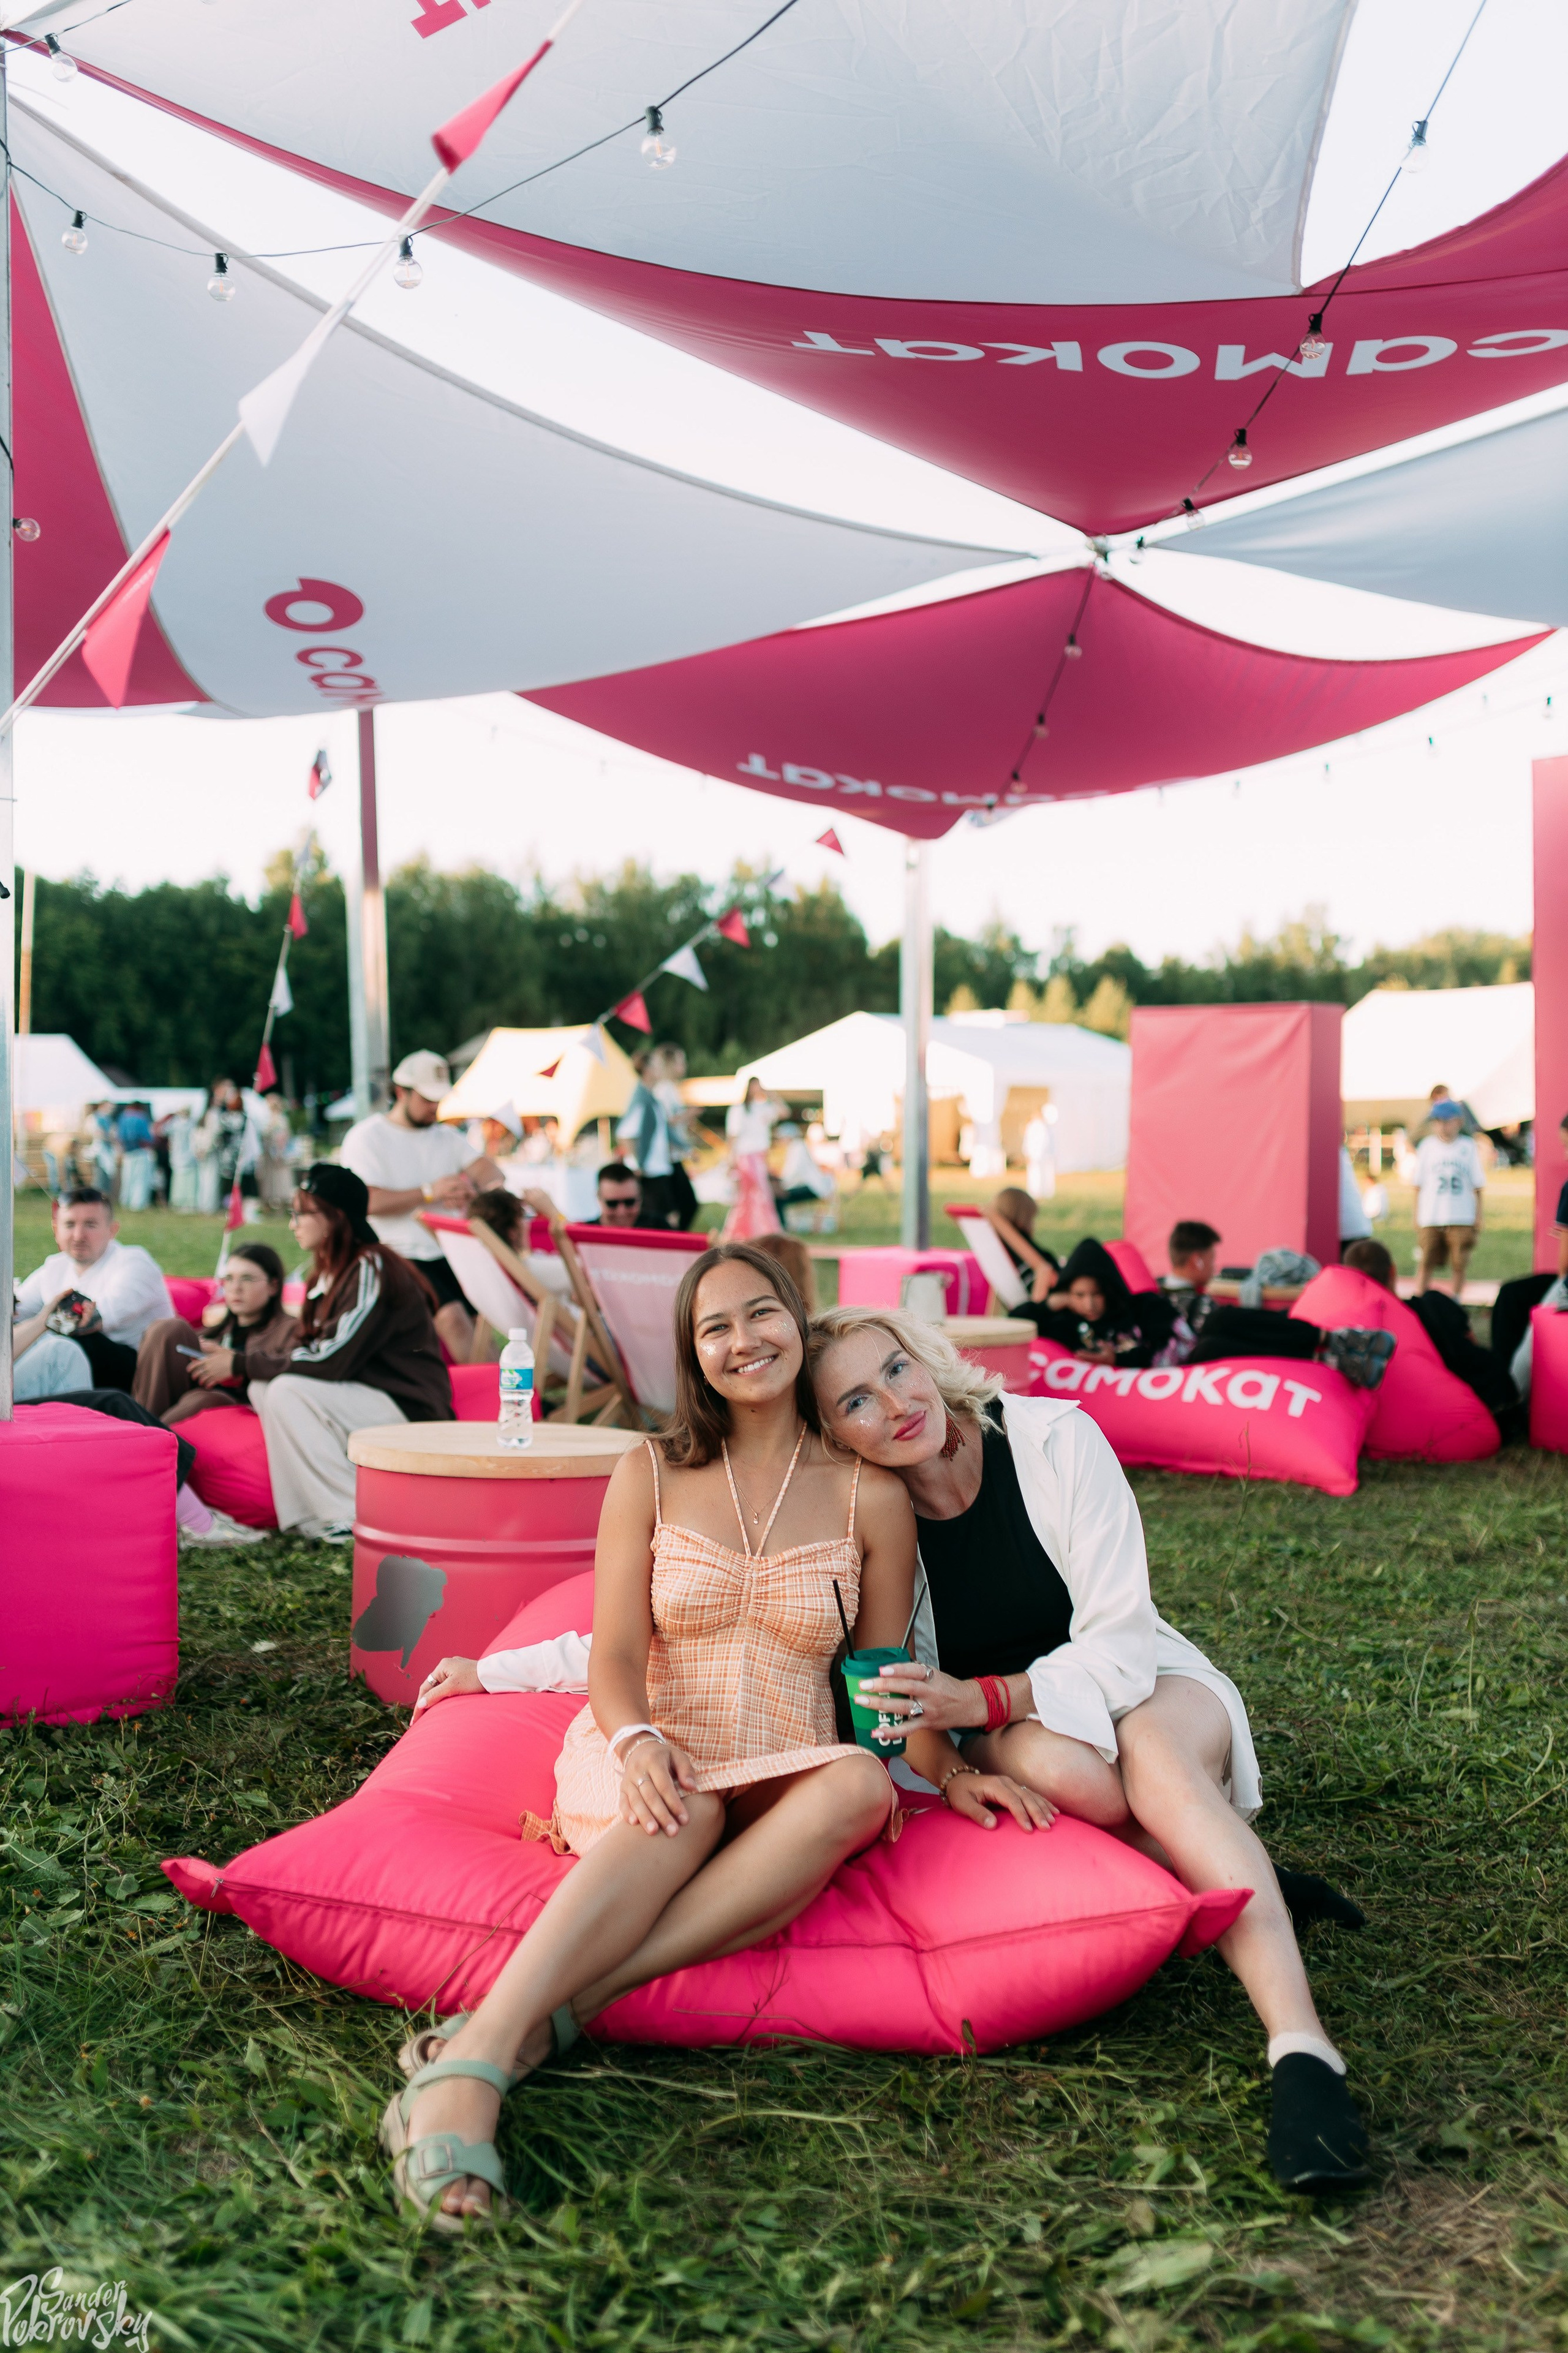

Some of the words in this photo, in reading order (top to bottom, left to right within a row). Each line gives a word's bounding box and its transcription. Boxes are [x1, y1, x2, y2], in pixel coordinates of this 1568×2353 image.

[791, 328, 1568, 380] самокат
[737, 753, 1109, 805] мокат
[892, 1713, 903, 1745] LKE
